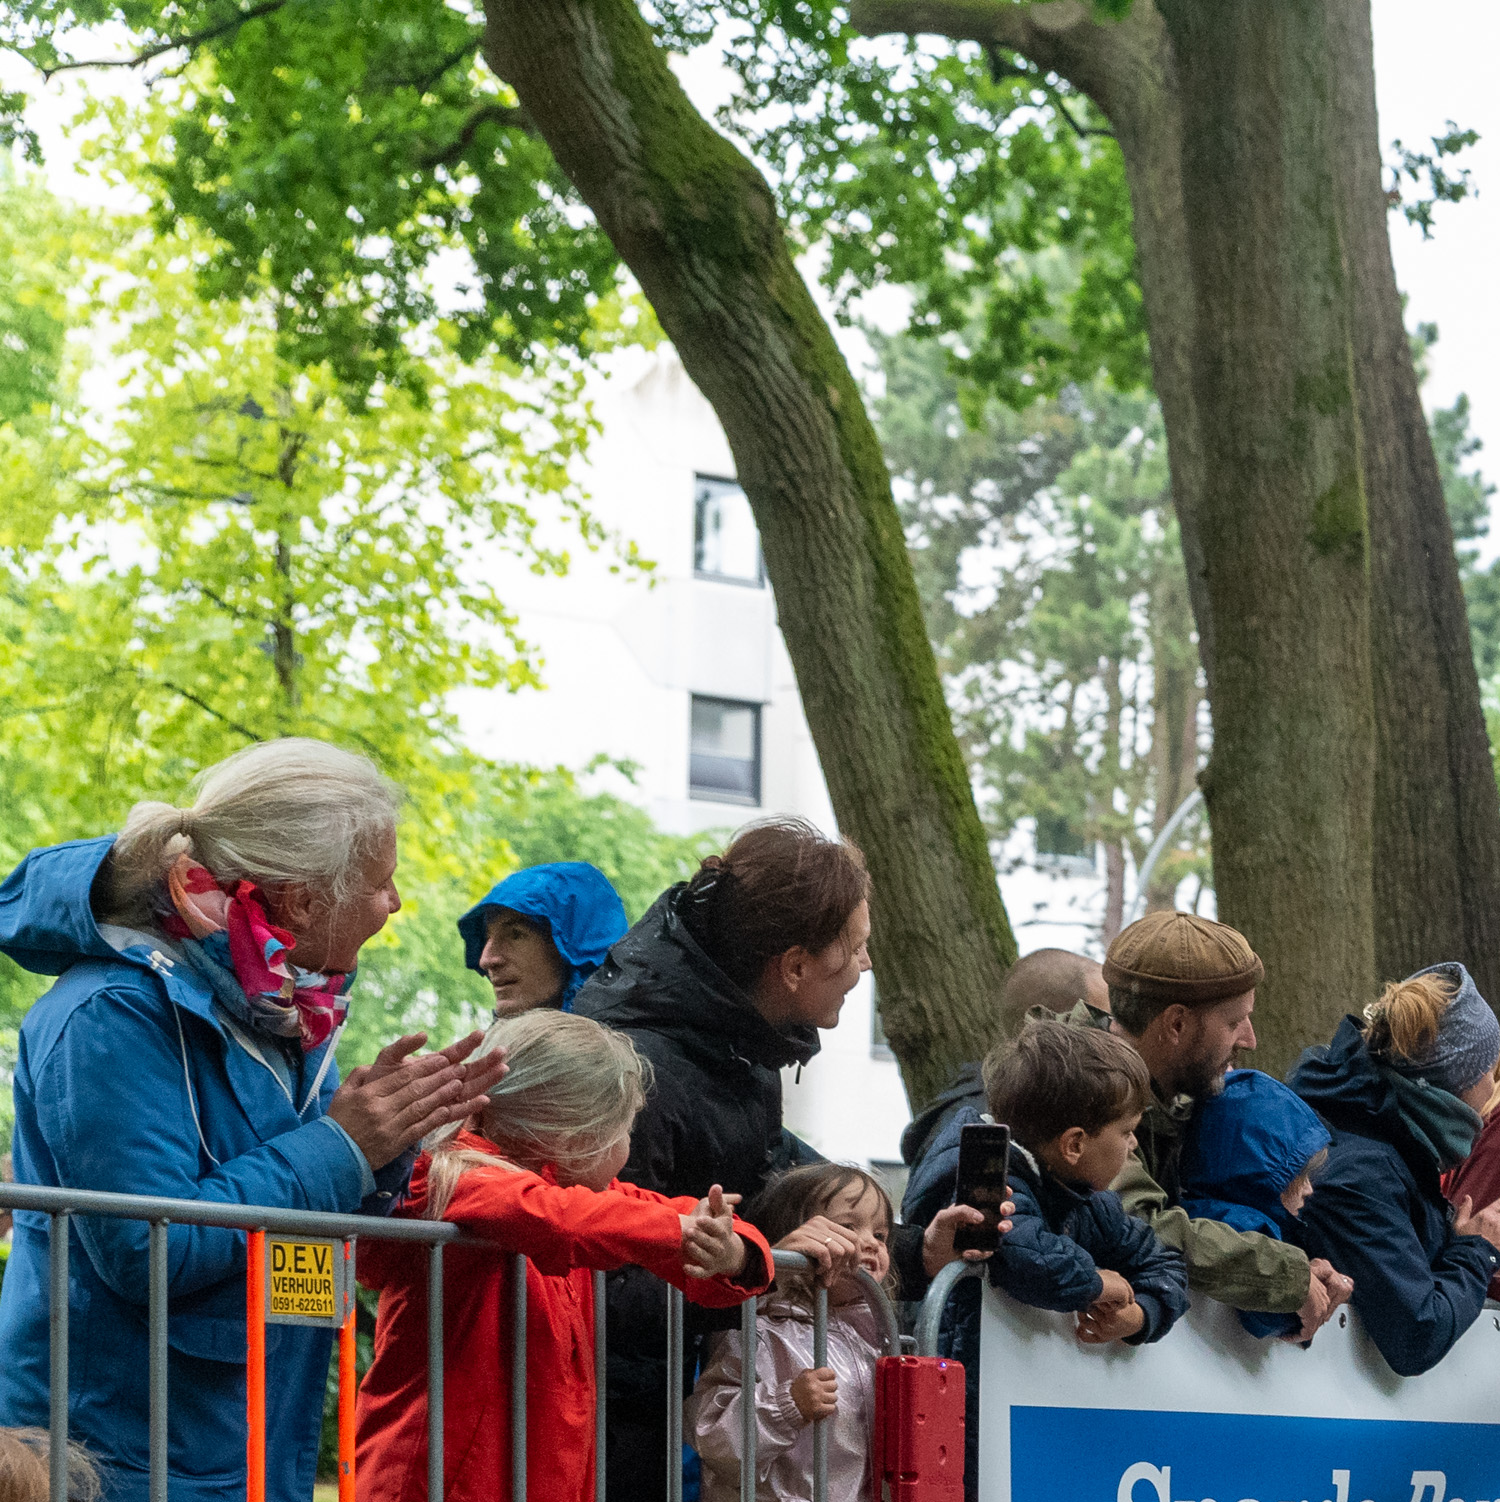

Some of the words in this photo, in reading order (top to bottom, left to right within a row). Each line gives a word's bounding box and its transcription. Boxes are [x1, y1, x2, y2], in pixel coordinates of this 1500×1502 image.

[272, 1244, 331, 1275] D.E.V.
[272, 1276, 332, 1295] VERHUUR
[272, 1296, 334, 1313] 0591-622611
